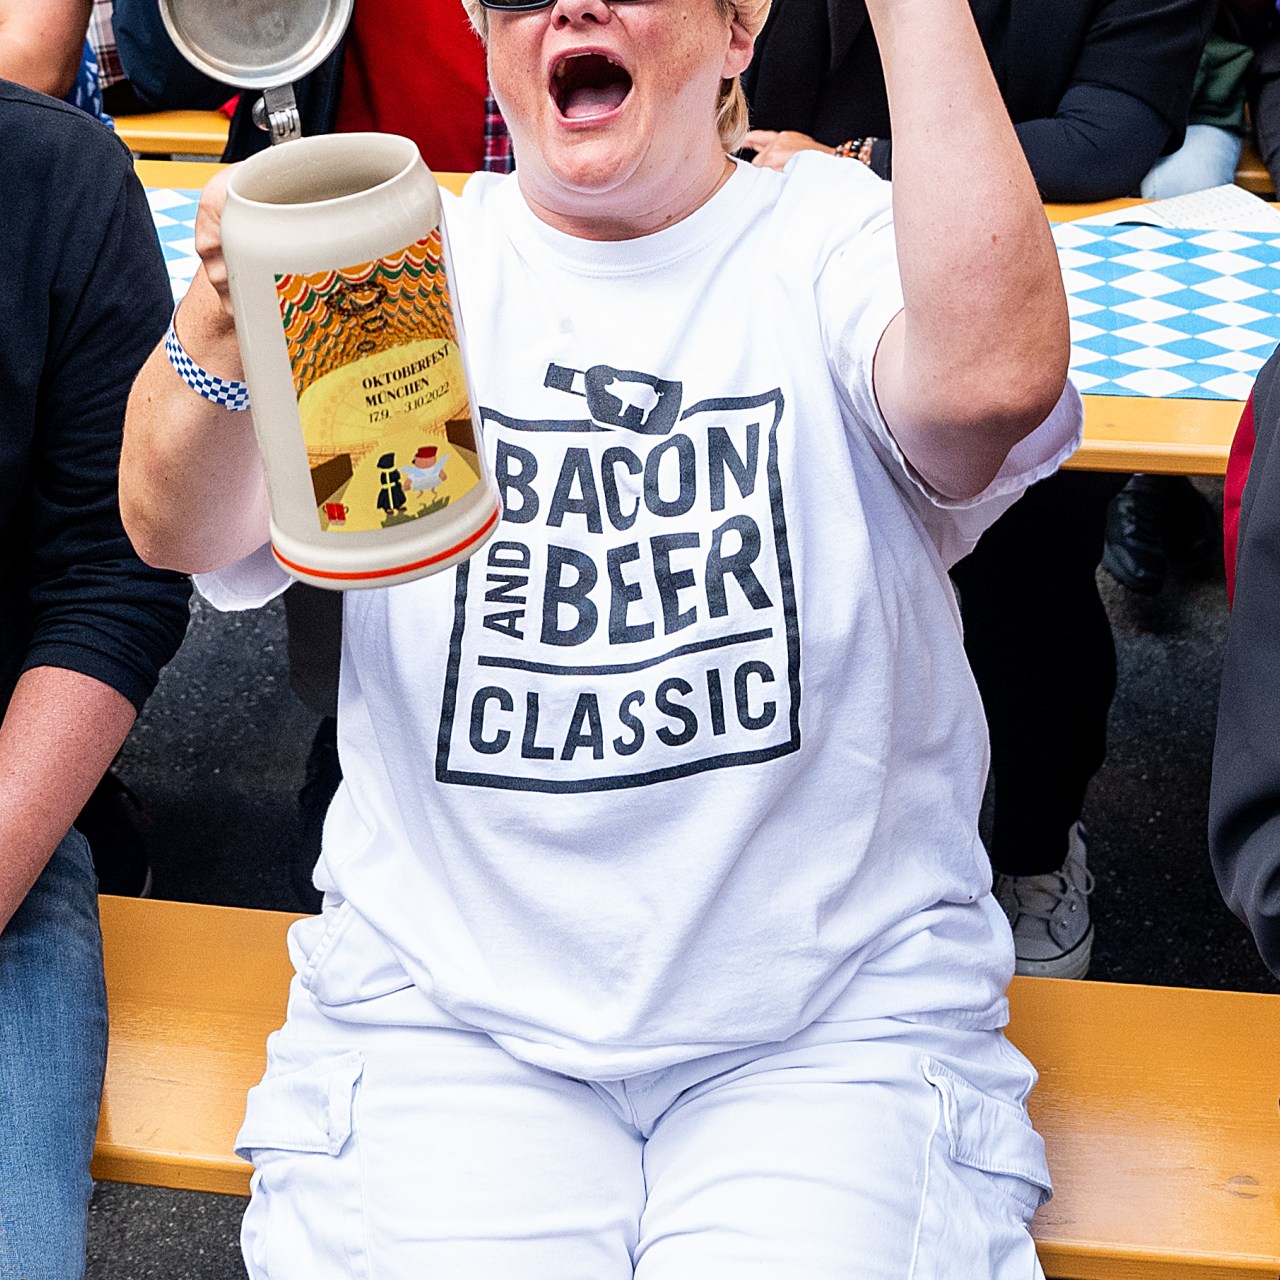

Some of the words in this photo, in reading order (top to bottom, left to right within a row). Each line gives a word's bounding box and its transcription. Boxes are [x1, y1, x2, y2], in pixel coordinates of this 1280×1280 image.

[362, 342, 450, 390] OKTOBERFEST
[403, 381, 450, 414] 3.10.2022
[495, 422, 760, 534] BACON
[482, 540, 531, 640] AND
[540, 515, 774, 646] BEER
[469, 660, 777, 761] CLASSIC
